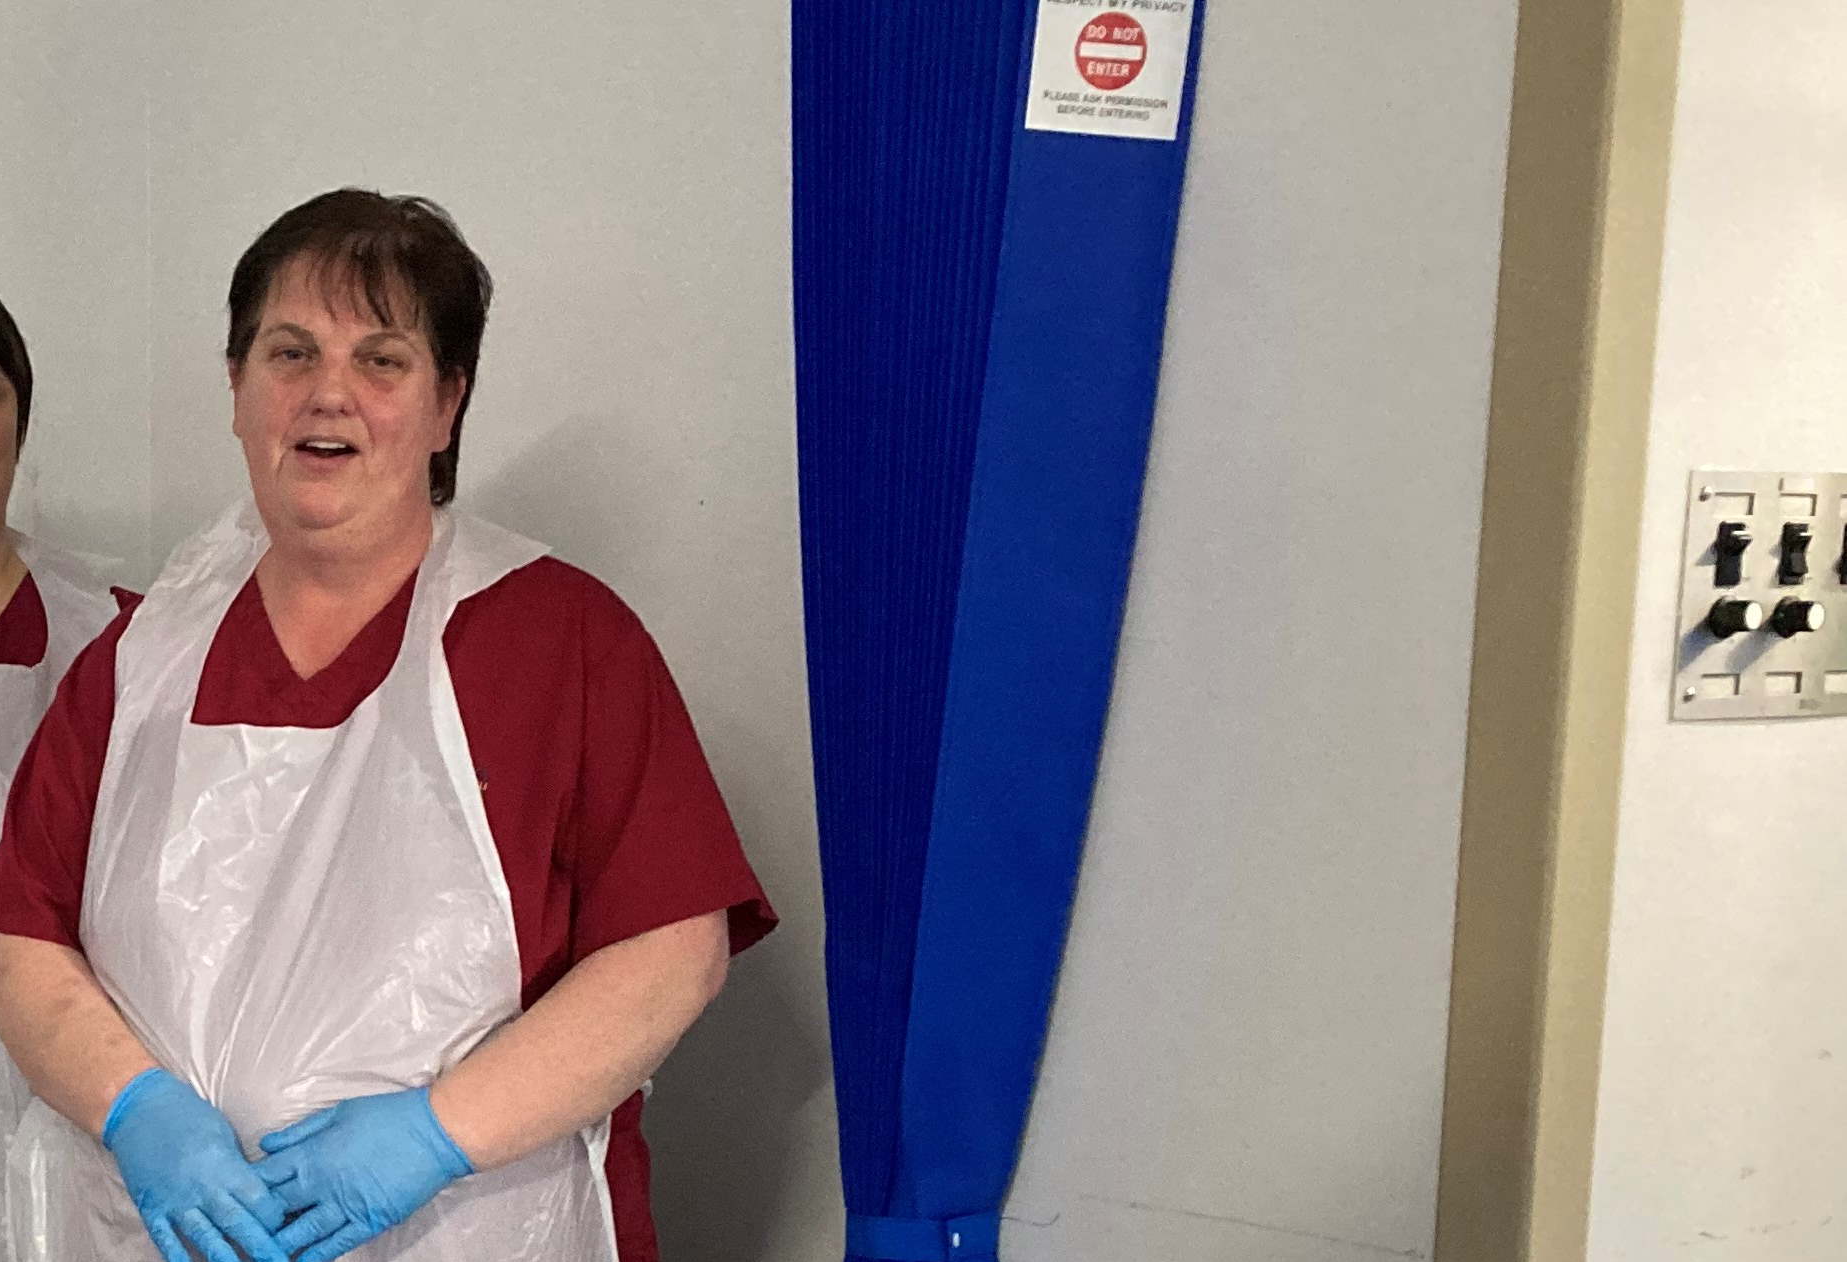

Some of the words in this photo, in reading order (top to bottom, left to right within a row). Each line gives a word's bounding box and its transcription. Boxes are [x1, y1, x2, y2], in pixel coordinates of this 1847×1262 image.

[1086, 24, 1107, 40] DO
[1112, 27, 1141, 42] NOT
[1087, 61, 1130, 77] ENTER
[1057, 104, 1096, 116] BEFORE
